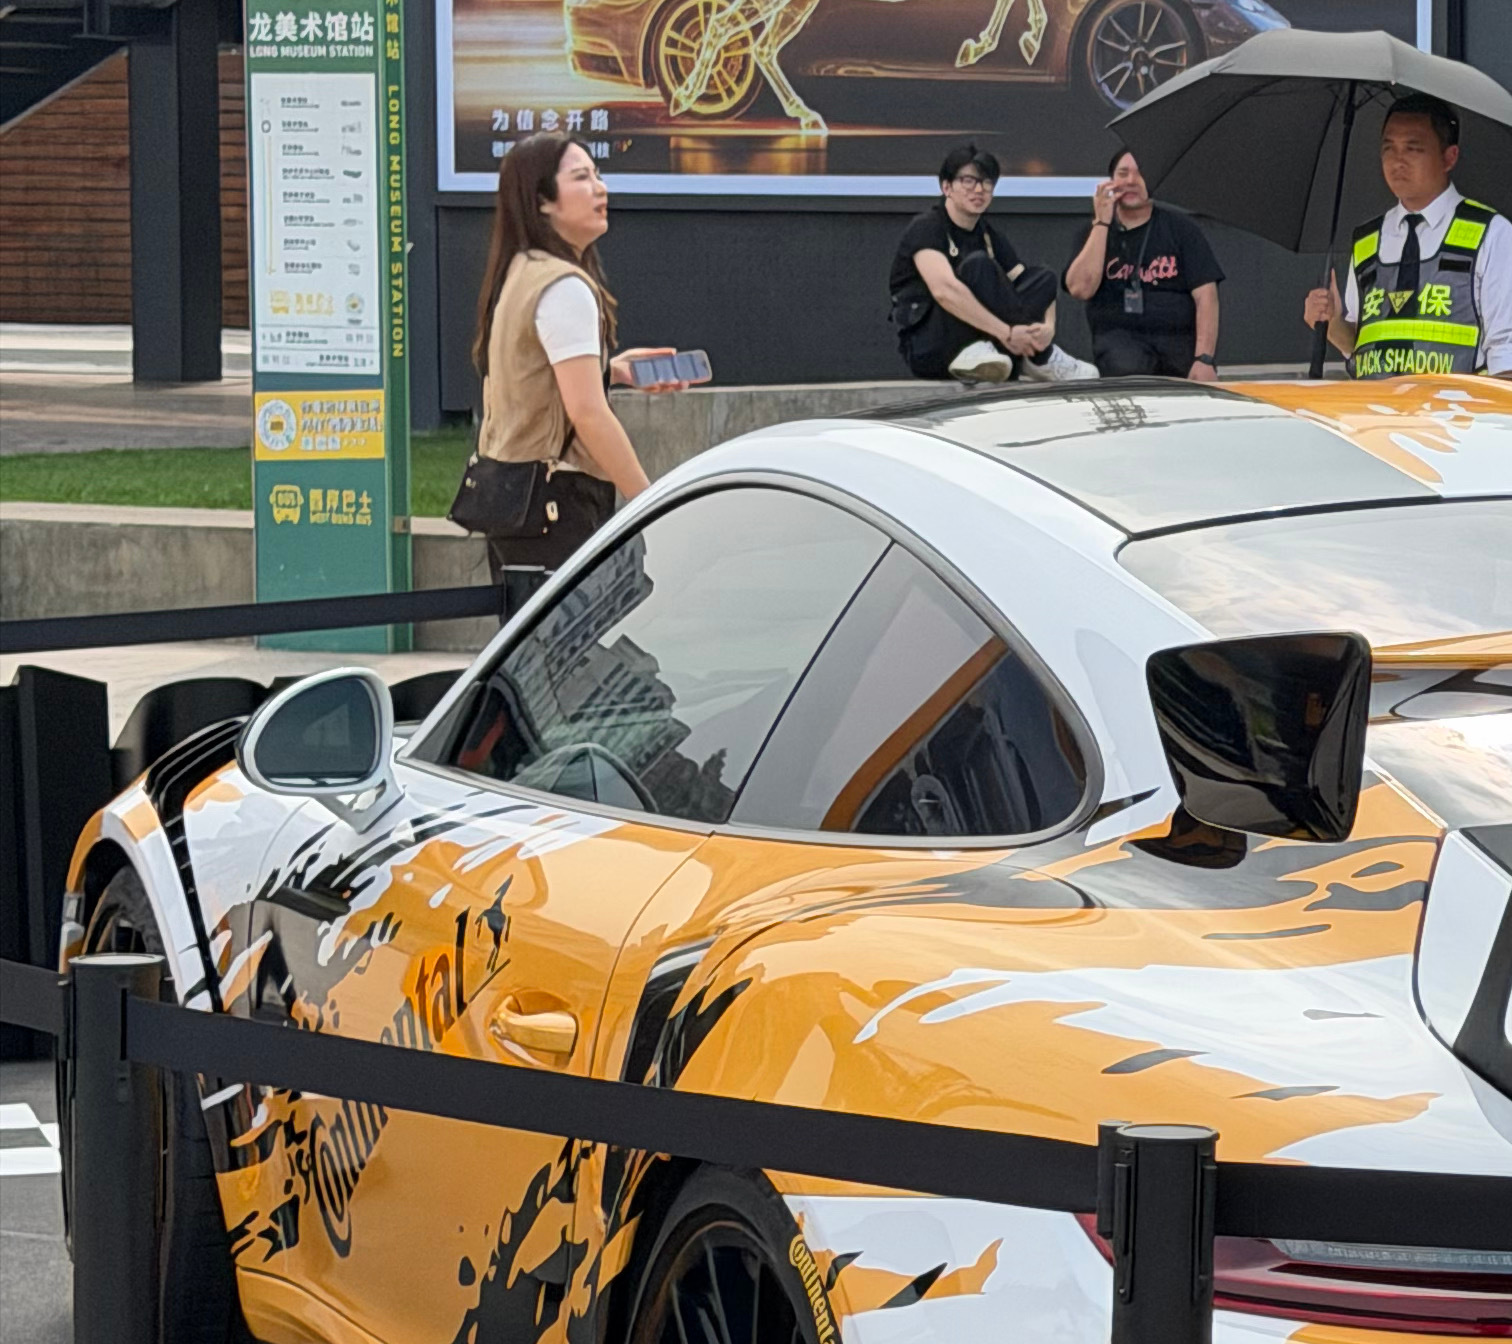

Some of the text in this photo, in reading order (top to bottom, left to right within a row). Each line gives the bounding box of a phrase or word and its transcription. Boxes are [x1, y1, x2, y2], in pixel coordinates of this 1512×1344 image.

[249, 11, 375, 42] 龙美术馆站
[249, 43, 374, 58] LONG MUSEUM STATION
[388, 85, 404, 358] LONG MUSEUM STATION
[1355, 348, 1455, 379] LACK SHADOW
